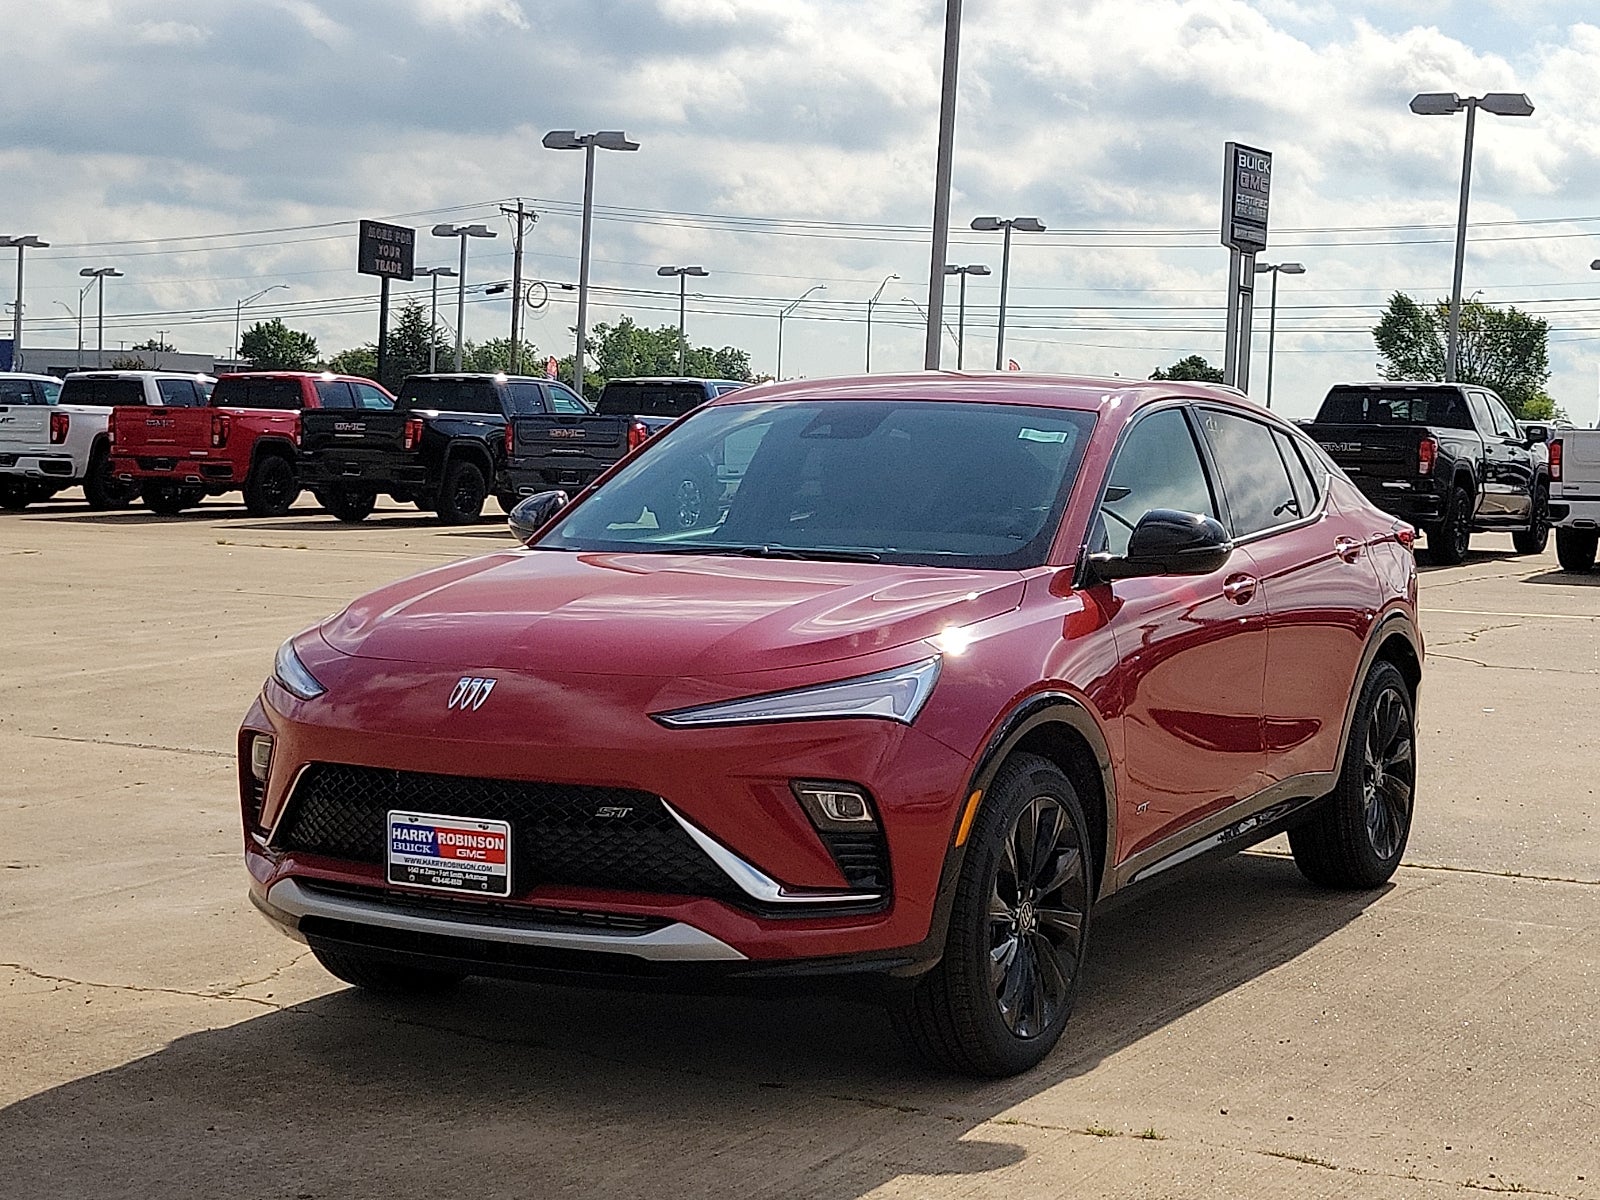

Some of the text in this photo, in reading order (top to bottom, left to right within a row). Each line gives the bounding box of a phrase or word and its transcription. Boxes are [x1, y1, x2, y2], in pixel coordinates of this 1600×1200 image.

[1239, 154, 1270, 174] BUICK
[1240, 172, 1268, 192] GMC
[379, 243, 400, 258] YOUR
[375, 259, 402, 274] TRADE
[334, 422, 366, 430] GMC
[549, 428, 585, 438] GMC
[392, 828, 505, 850] HARRY ROBINSON
[393, 841, 432, 854] BUICK
[456, 848, 486, 859] GMC
